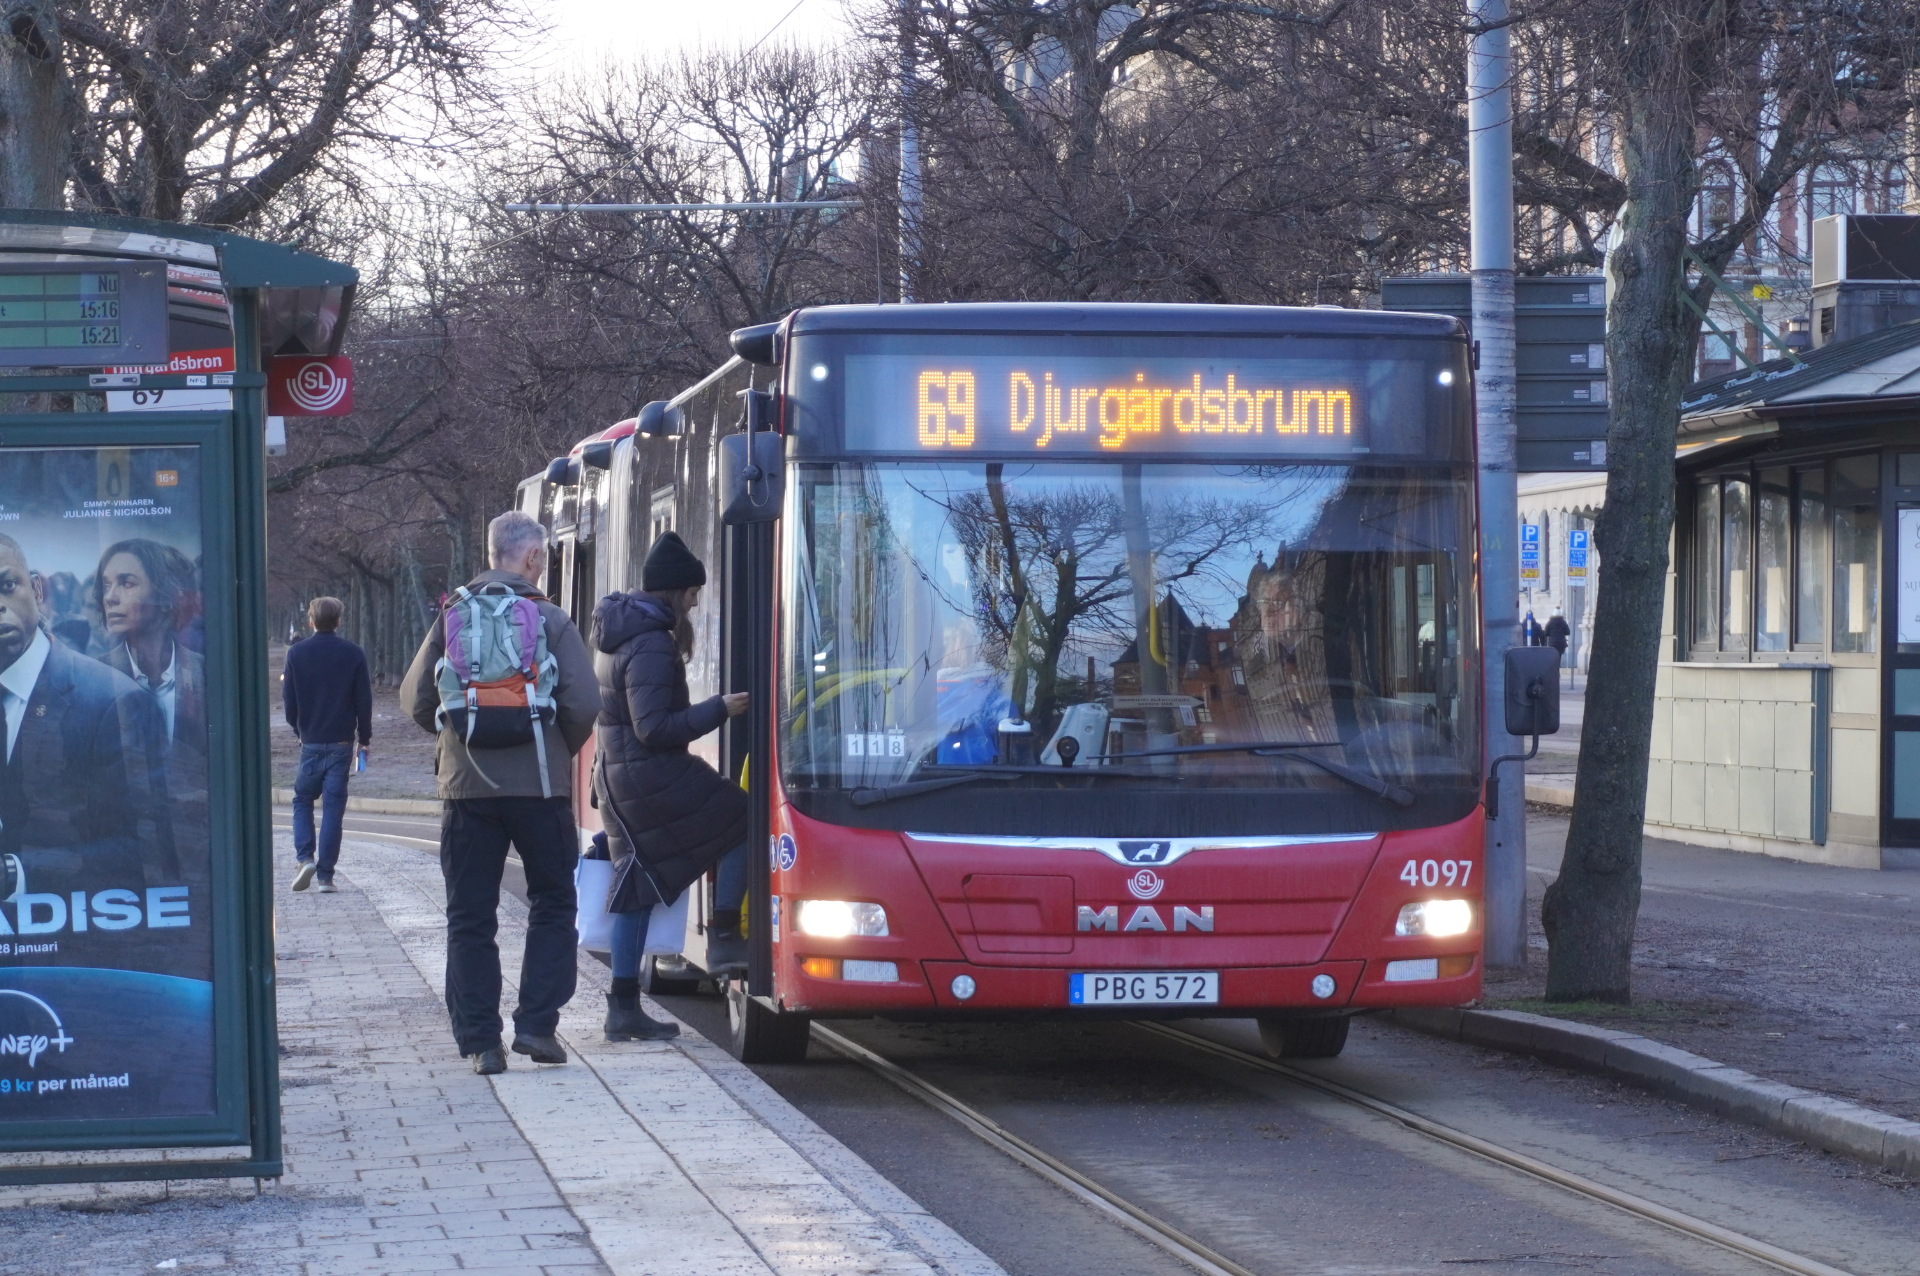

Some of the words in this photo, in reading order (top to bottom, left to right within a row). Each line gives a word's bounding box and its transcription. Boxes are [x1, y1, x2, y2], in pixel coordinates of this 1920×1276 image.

[98, 275, 117, 292] Nu
[80, 301, 118, 318] 15:16
[81, 327, 118, 344] 15:21
[304, 371, 330, 390] SL
[918, 371, 975, 446] 69
[1011, 373, 1352, 447] Djurgårdsbrunn
[157, 474, 176, 483] 16+
[63, 509, 112, 519] JULIANNE
[114, 507, 172, 516] NICHOLSON
[1526, 526, 1536, 541] P
[1574, 532, 1585, 547] P
[1138, 875, 1154, 887] SL
[1400, 860, 1473, 887] 4097
[1077, 906, 1214, 932] MAN
[14, 941, 58, 956] januari
[1094, 977, 1146, 1000] PBG
[1155, 976, 1206, 1000] 572
[16, 1078, 34, 1091] kr
[38, 1077, 67, 1094] per
[71, 1073, 130, 1089] månad
